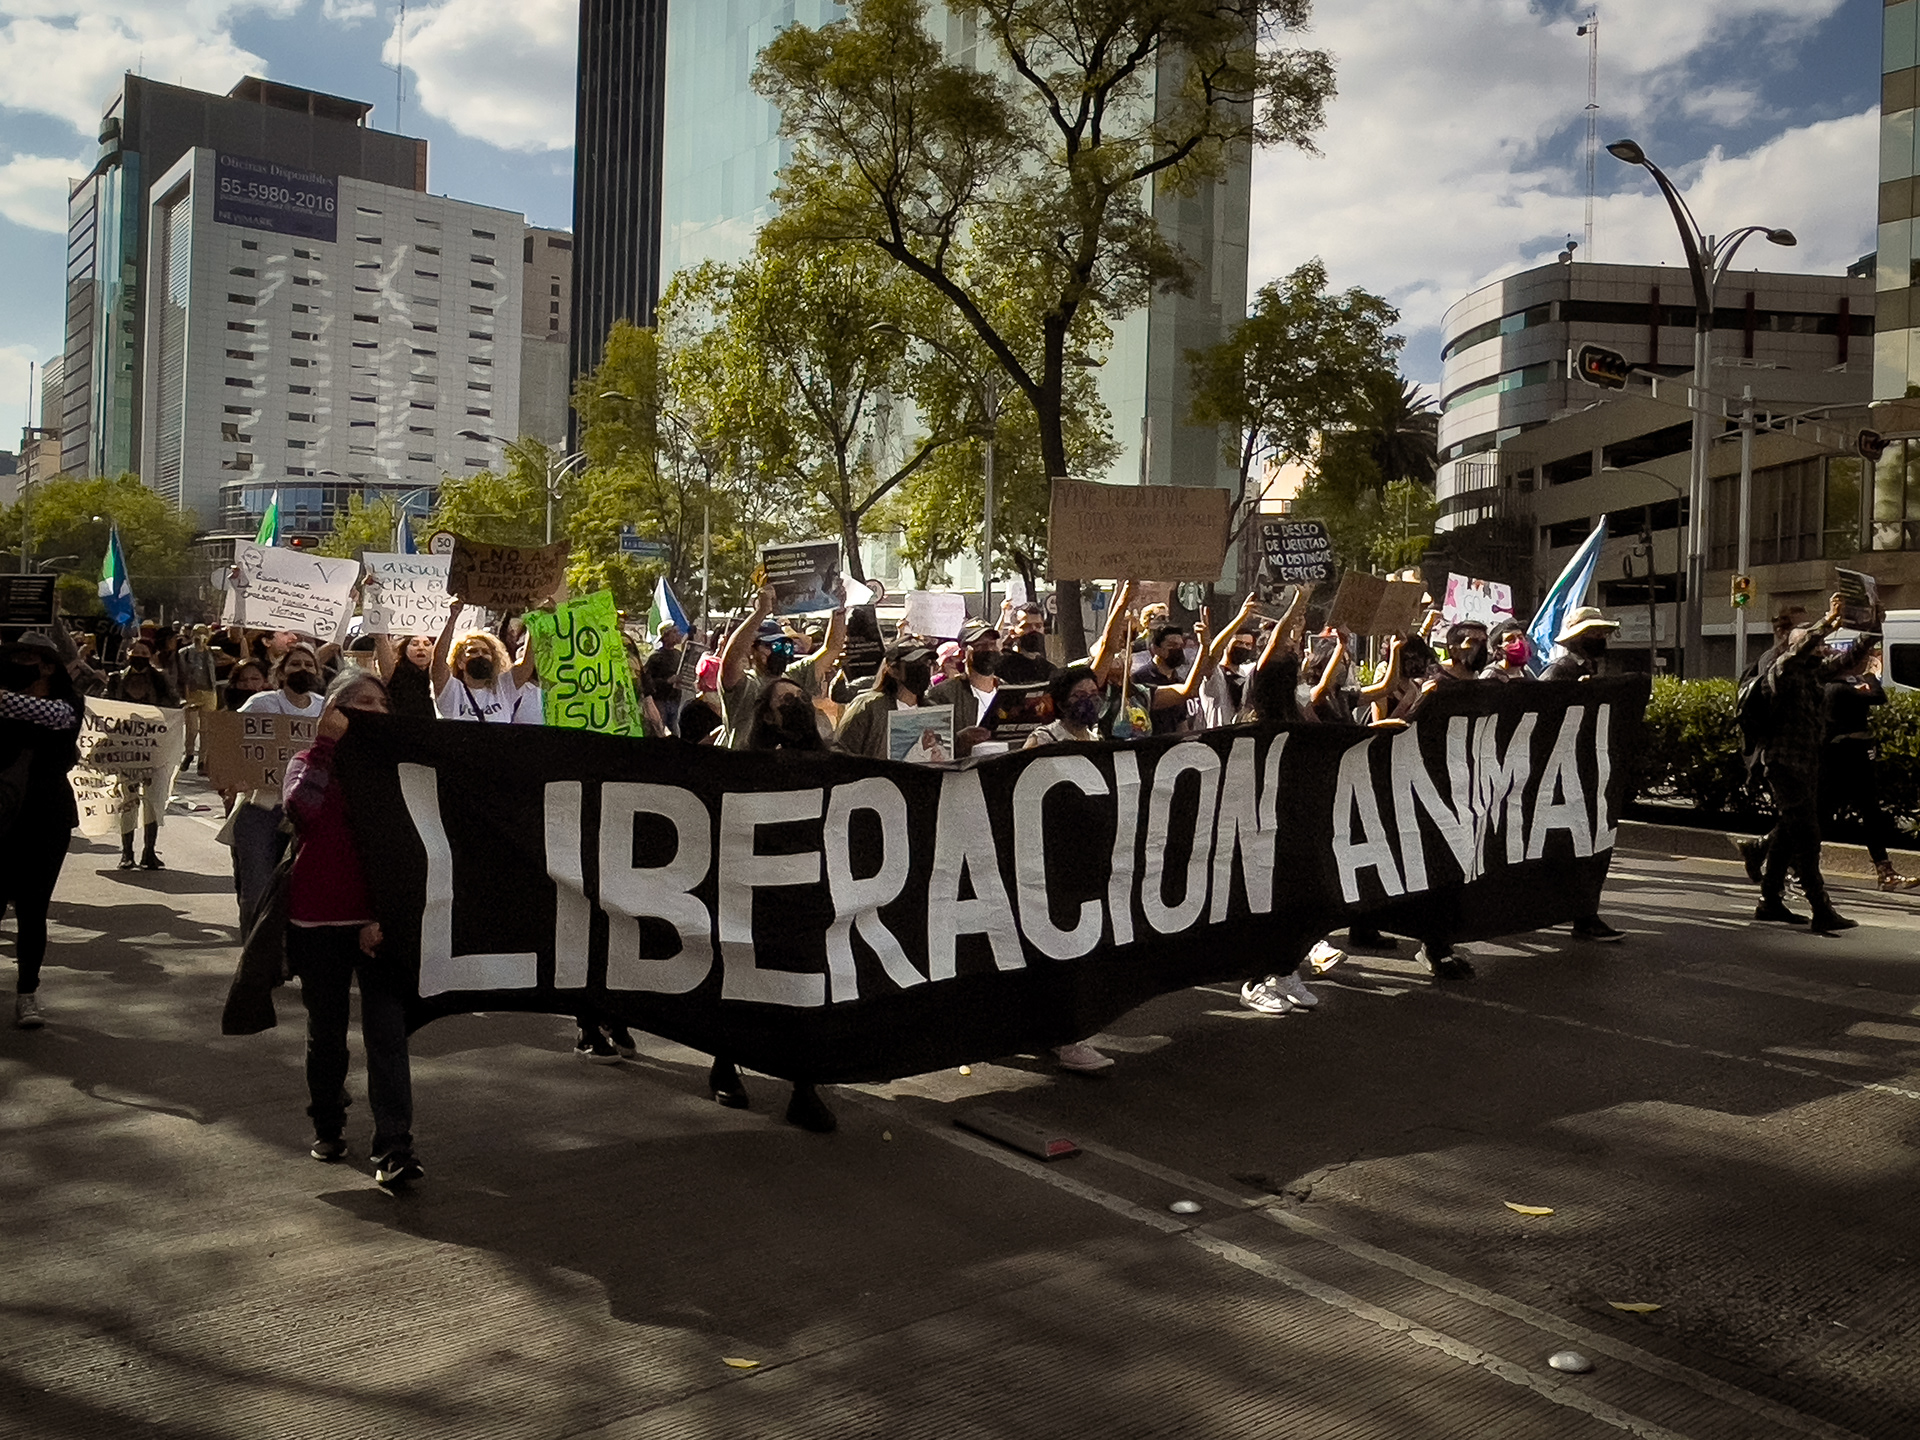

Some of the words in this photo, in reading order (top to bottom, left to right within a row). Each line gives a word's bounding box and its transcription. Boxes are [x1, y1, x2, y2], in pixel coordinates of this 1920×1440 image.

[220, 177, 335, 213] 55-5980-2016
[1263, 525, 1279, 536] EL
[1281, 523, 1319, 537] DESEO
[437, 537, 451, 548] 50
[1265, 540, 1280, 552] DE
[490, 548, 521, 562] NO
[1268, 553, 1284, 566] NO
[1286, 549, 1333, 566] DISTINGUE
[1463, 594, 1482, 614] GO
[83, 714, 168, 737] VEGANISMO
[245, 717, 275, 736] BE
[290, 720, 313, 738] KI
[80, 736, 94, 748] ES
[241, 744, 265, 761] TO
[397, 729, 1290, 1011] LIBERACION
[1330, 702, 1619, 906] ANIMAL
